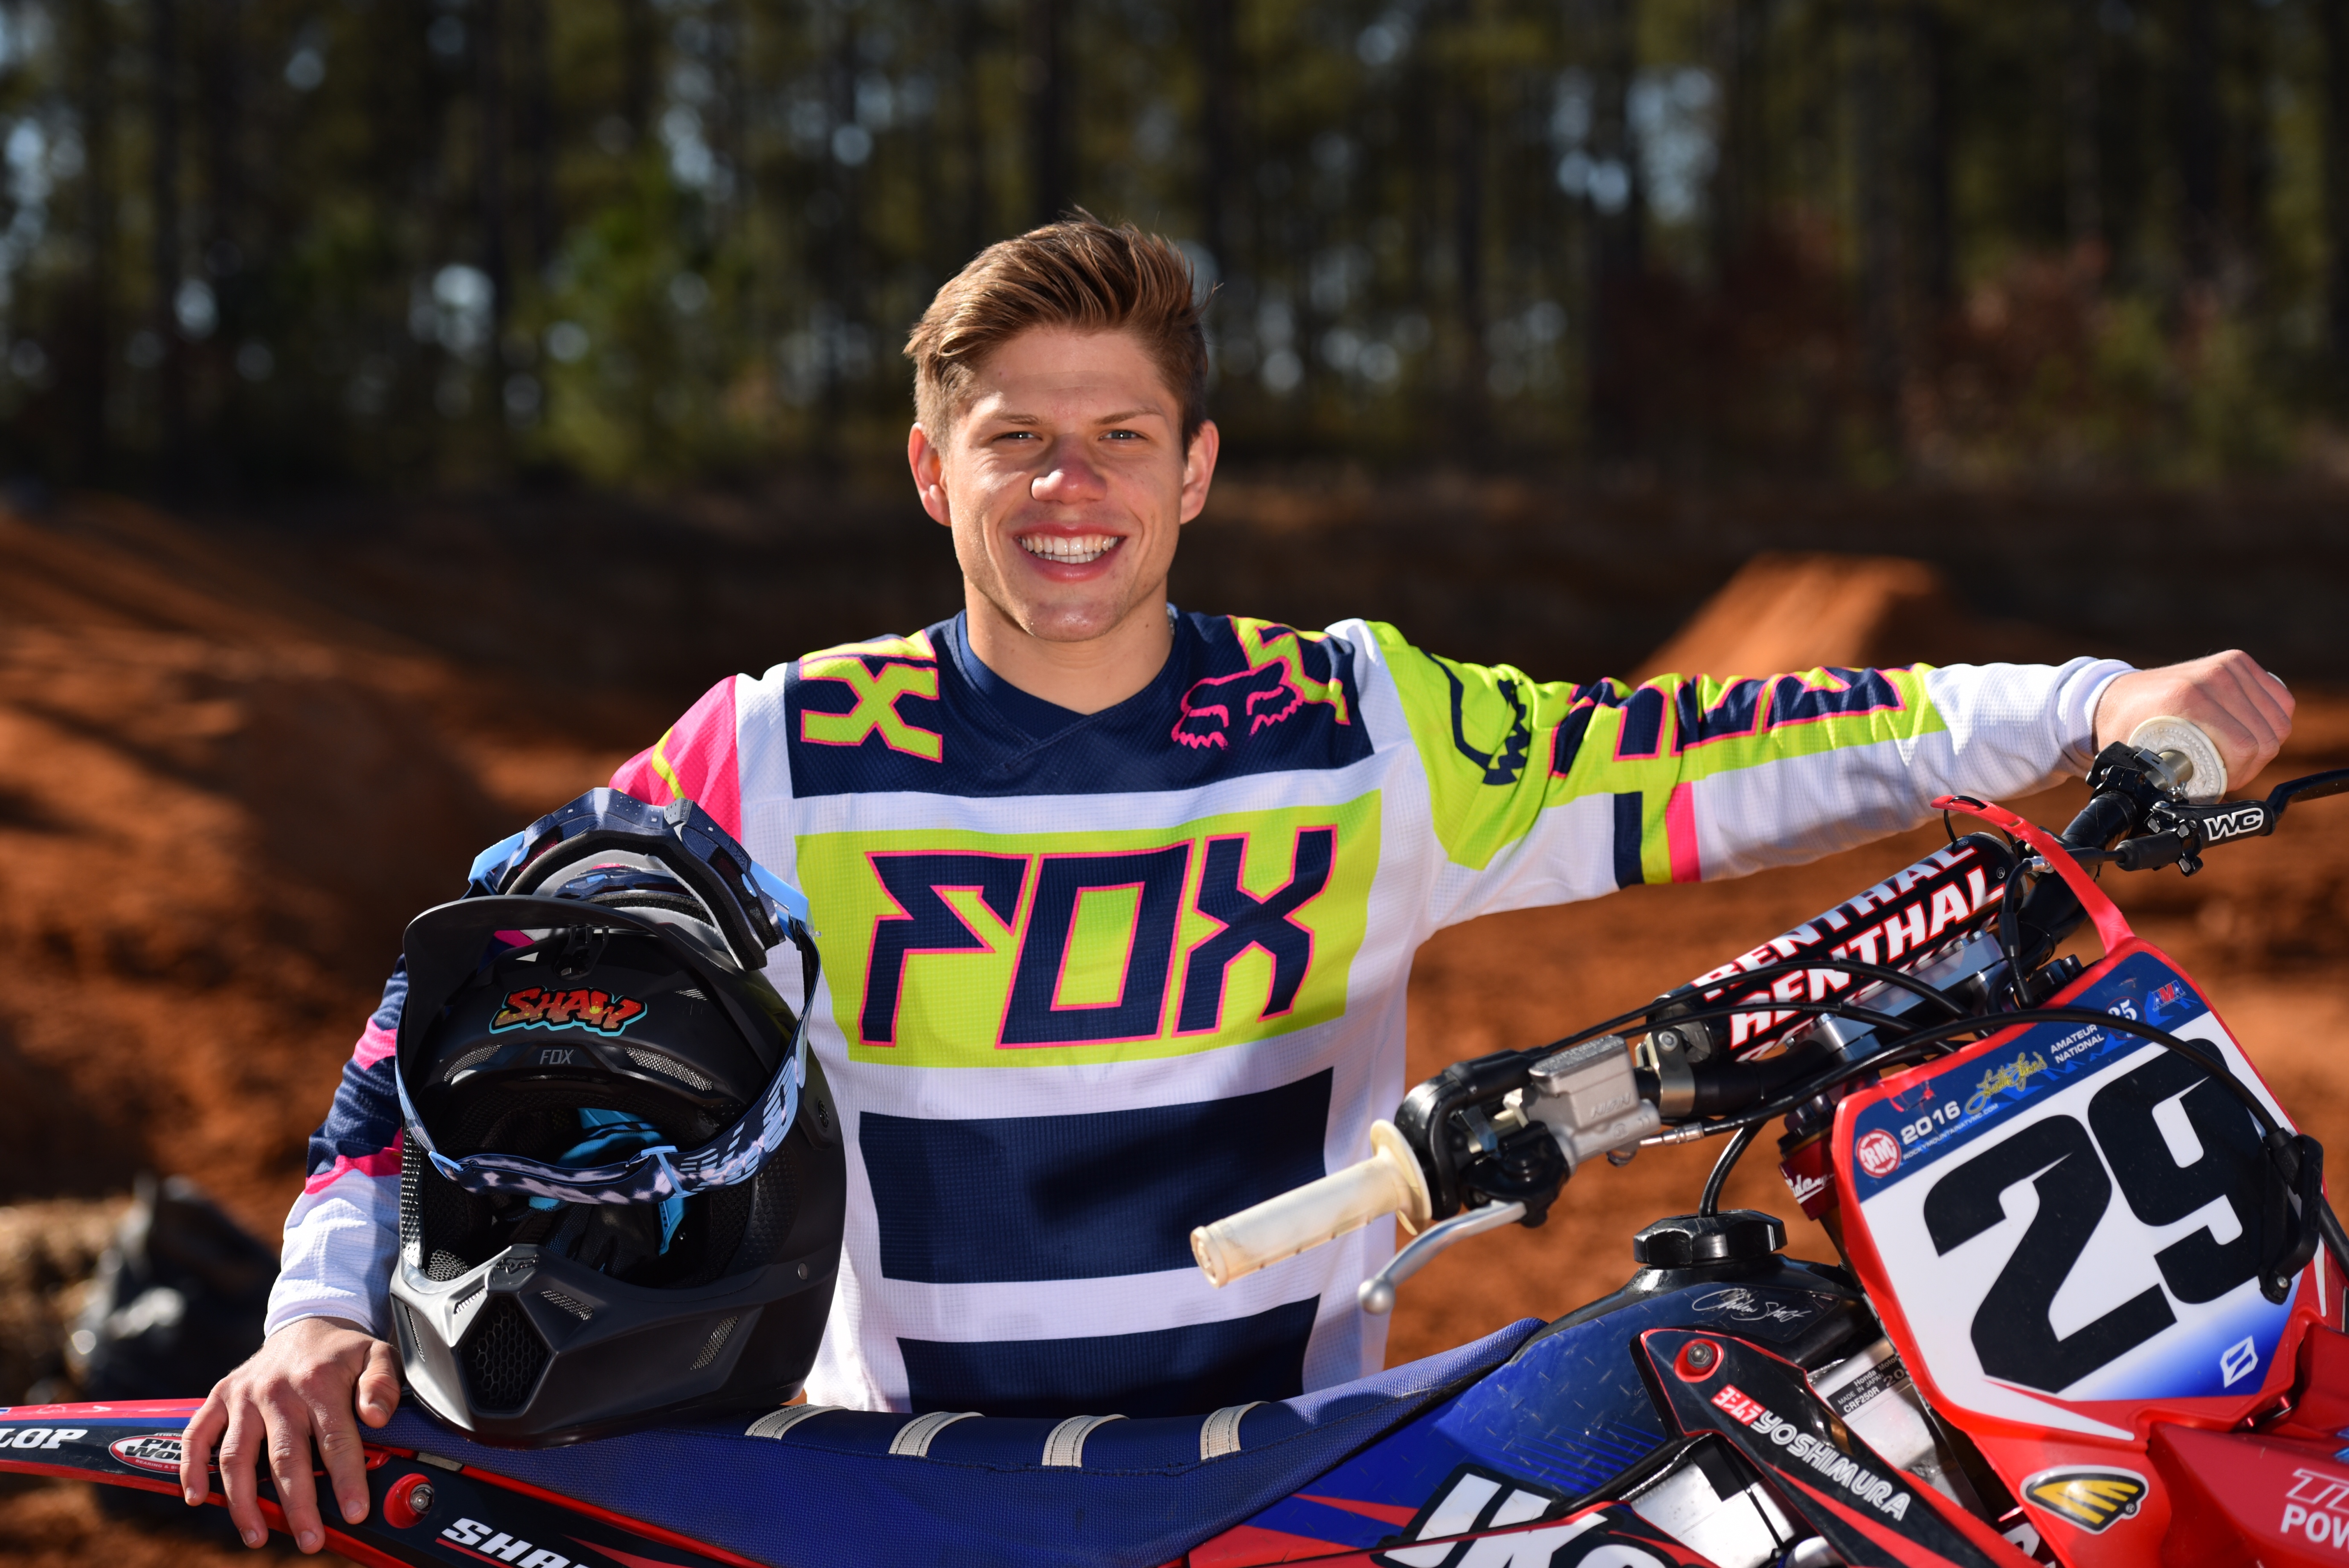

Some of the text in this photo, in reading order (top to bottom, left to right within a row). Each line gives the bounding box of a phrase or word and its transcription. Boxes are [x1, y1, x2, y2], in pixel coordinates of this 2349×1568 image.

[2203, 807, 2264, 841] WC
[858, 823, 1338, 1049] FOX
[1691, 846, 1978, 1003] RENTHAL
[1729, 866, 2006, 1050] RENTHAL
[490, 986, 647, 1034] SHAW
[2152, 980, 2186, 1011] AMA
[539, 1048, 576, 1064] FOX
[2050, 1024, 2098, 1054] AMATEUR
[2054, 1034, 2105, 1064] NATIONAL
[1900, 1100, 1961, 1145] 2016
[1902, 1103, 1999, 1160] ROCKYMOUNTAINATVMC.COM
[1924, 1038, 2265, 1394] 29
[1853, 1355, 1898, 1387] Honda Motor
[1714, 1387, 1763, 1423] ヨシムラ
[1838, 1390, 1856, 1406] MADE
[1866, 1373, 1884, 1388] JAPAN
[1843, 1386, 1880, 1413] CRF250R
[135, 1459, 162, 1468] BEARING
[1750, 1410, 1911, 1522] YOSHIMURA
[441, 1518, 591, 1568] SHA
